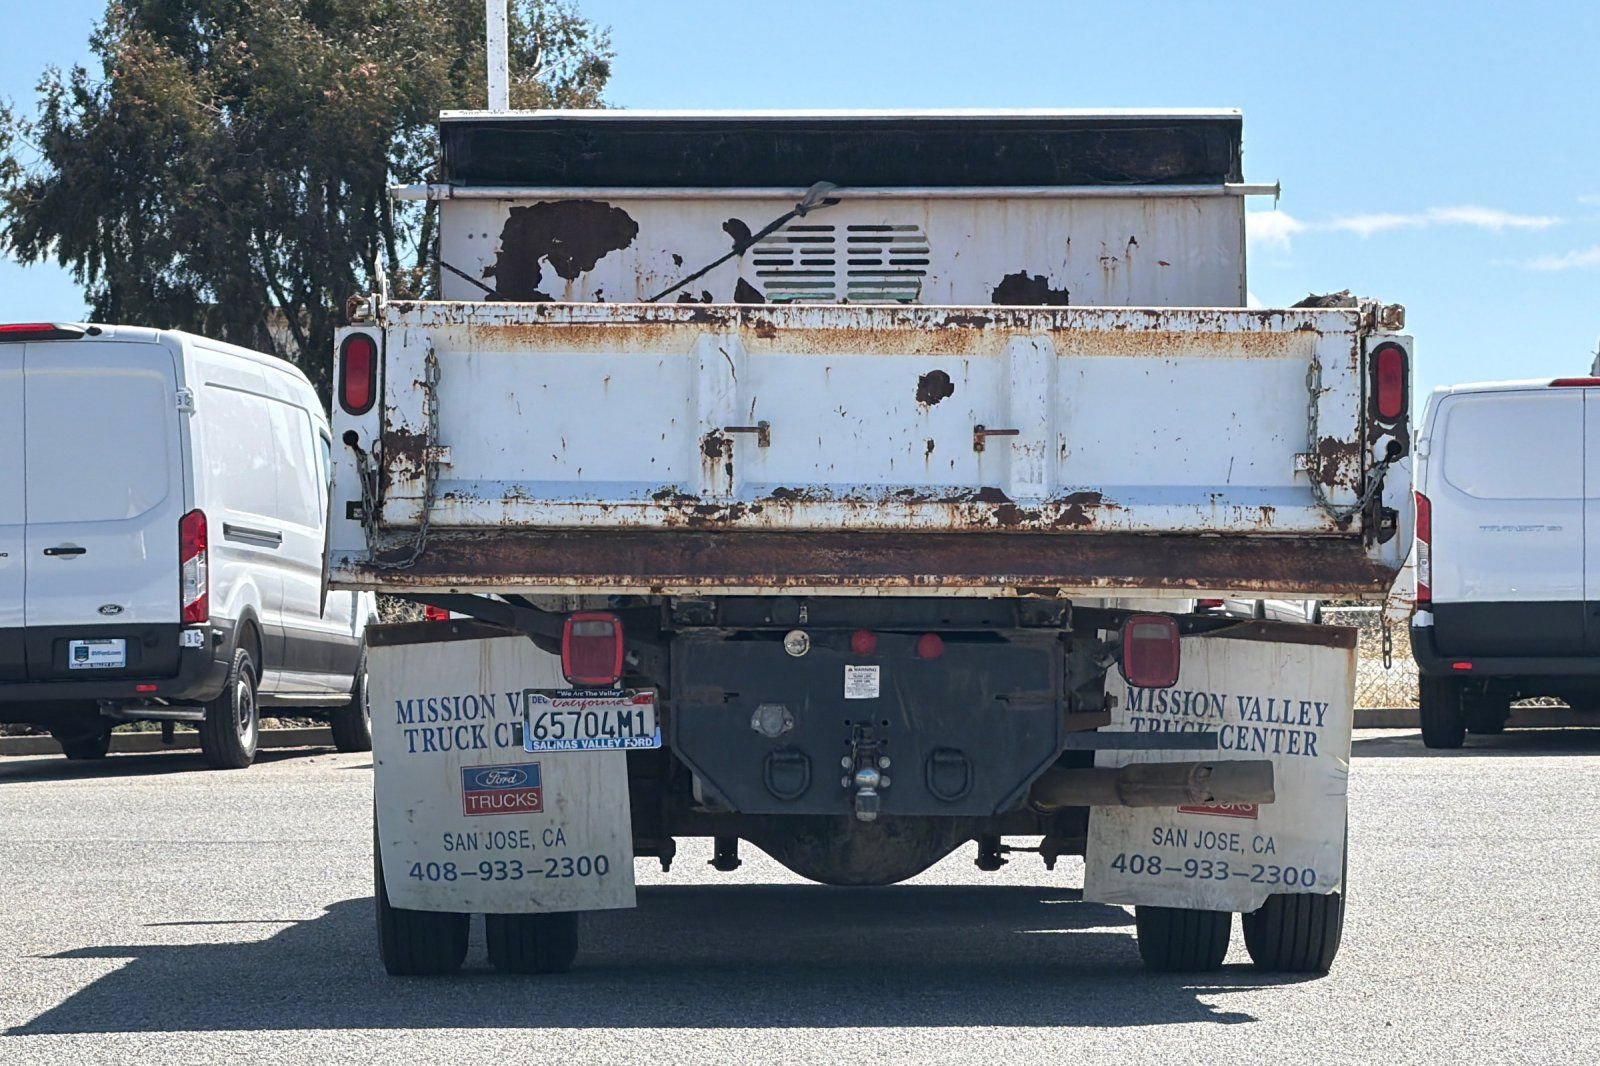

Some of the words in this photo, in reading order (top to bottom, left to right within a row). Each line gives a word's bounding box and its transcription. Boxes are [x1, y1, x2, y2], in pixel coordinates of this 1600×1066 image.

[396, 693, 497, 725] MISSION
[550, 698, 633, 711] California
[1125, 687, 1227, 719] MISSION
[1236, 696, 1329, 727] VALLEY
[404, 724, 488, 753] TRUCK
[533, 710, 650, 740] 65704M1
[533, 740, 578, 750] SALINAS
[581, 739, 623, 748] VALLEY
[624, 738, 653, 748] FORD
[1219, 725, 1318, 757] CENTER
[484, 770, 517, 787] Ford
[468, 792, 538, 809] TRUCKS
[443, 832, 478, 851] SAN
[485, 829, 536, 851] JOSE,
[542, 828, 567, 847] CA
[1152, 827, 1188, 848] SAN
[1194, 831, 1245, 855] JOSE,
[1252, 835, 1276, 855] CA
[409, 854, 610, 882] 408-933-2300
[1111, 853, 1317, 887] 408-933-2300
